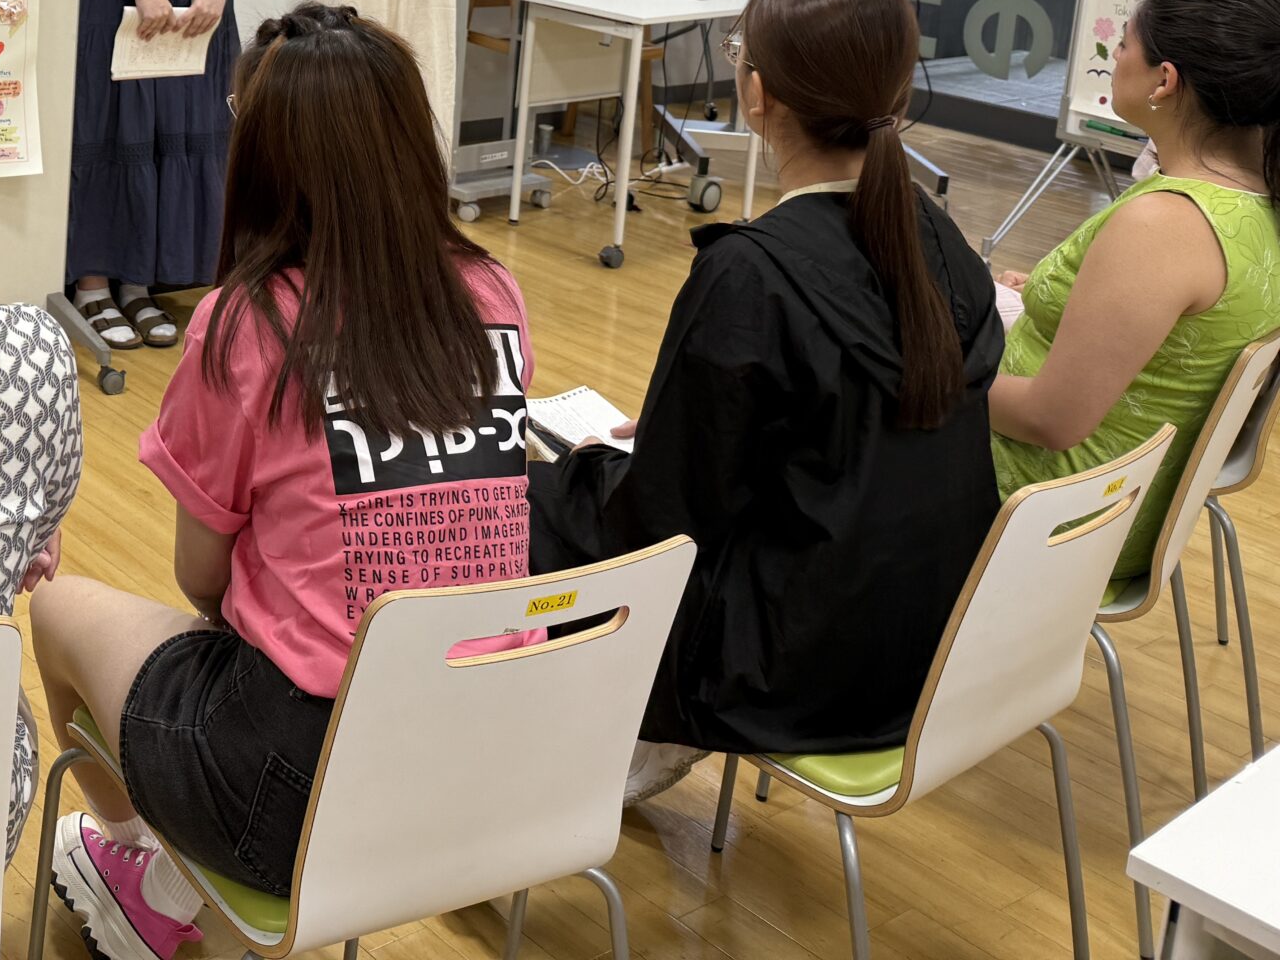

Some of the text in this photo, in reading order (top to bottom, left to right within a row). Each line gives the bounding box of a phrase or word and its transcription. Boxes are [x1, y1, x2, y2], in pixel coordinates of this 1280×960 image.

[400, 493, 414, 508] IS
[420, 489, 471, 507] TRYING
[474, 487, 489, 503] TO
[493, 486, 512, 501] GET
[339, 512, 369, 527] THE
[374, 509, 445, 528] CONFINES
[448, 509, 465, 524] OF
[469, 505, 504, 522] PUNK,
[342, 527, 468, 547] UNDERGROUND
[343, 550, 406, 565] TRYING
[412, 549, 429, 564] TO
[435, 543, 506, 562] RECREATE
[344, 567, 410, 584] SENSE
[421, 567, 440, 583] OF
[528, 594, 573, 613] No.21
